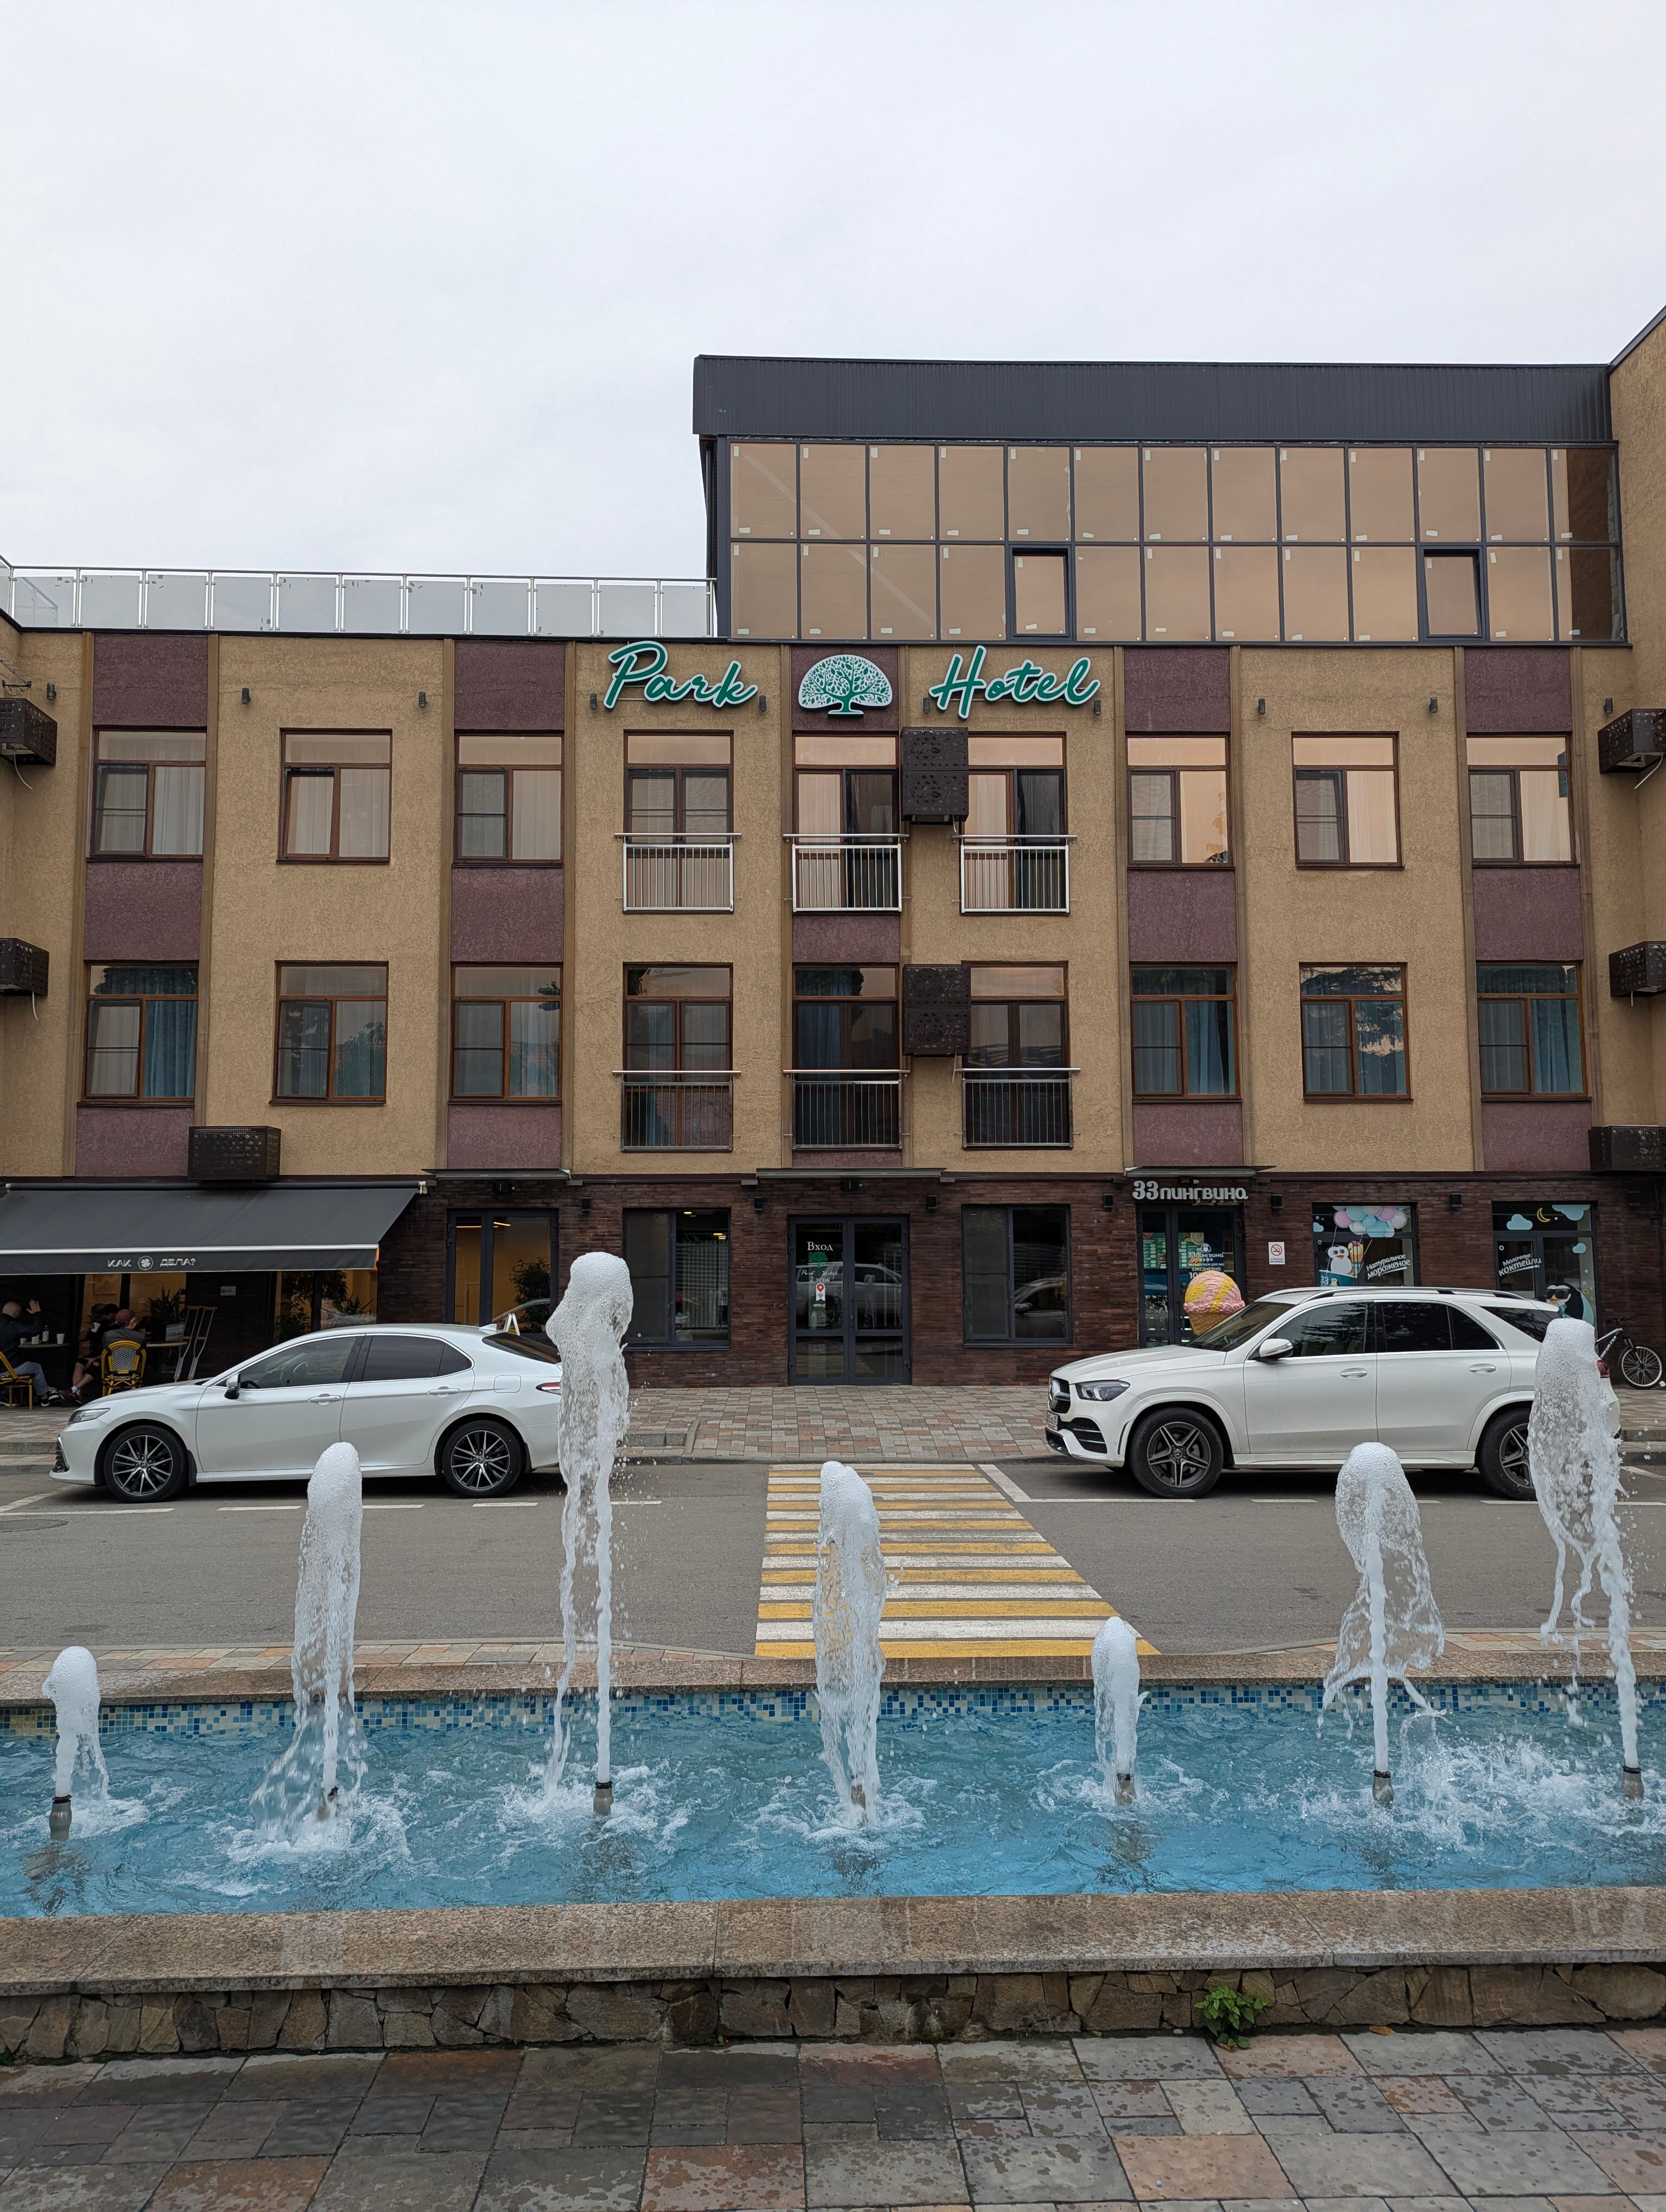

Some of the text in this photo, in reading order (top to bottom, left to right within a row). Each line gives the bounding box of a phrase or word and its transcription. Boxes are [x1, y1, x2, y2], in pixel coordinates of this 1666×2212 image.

[603, 640, 1101, 719] Park Hotel
[1132, 1180, 1248, 1200] 33 пингвина
[807, 1241, 833, 1251] Вход
[159, 1258, 196, 1268] ДЕЛА?
[1366, 1254, 1406, 1271] Натуральное
[1498, 1258, 1542, 1276] коктейли
[1503, 1253, 1532, 1266] Молочные
[1367, 1259, 1411, 1279] мороженое
